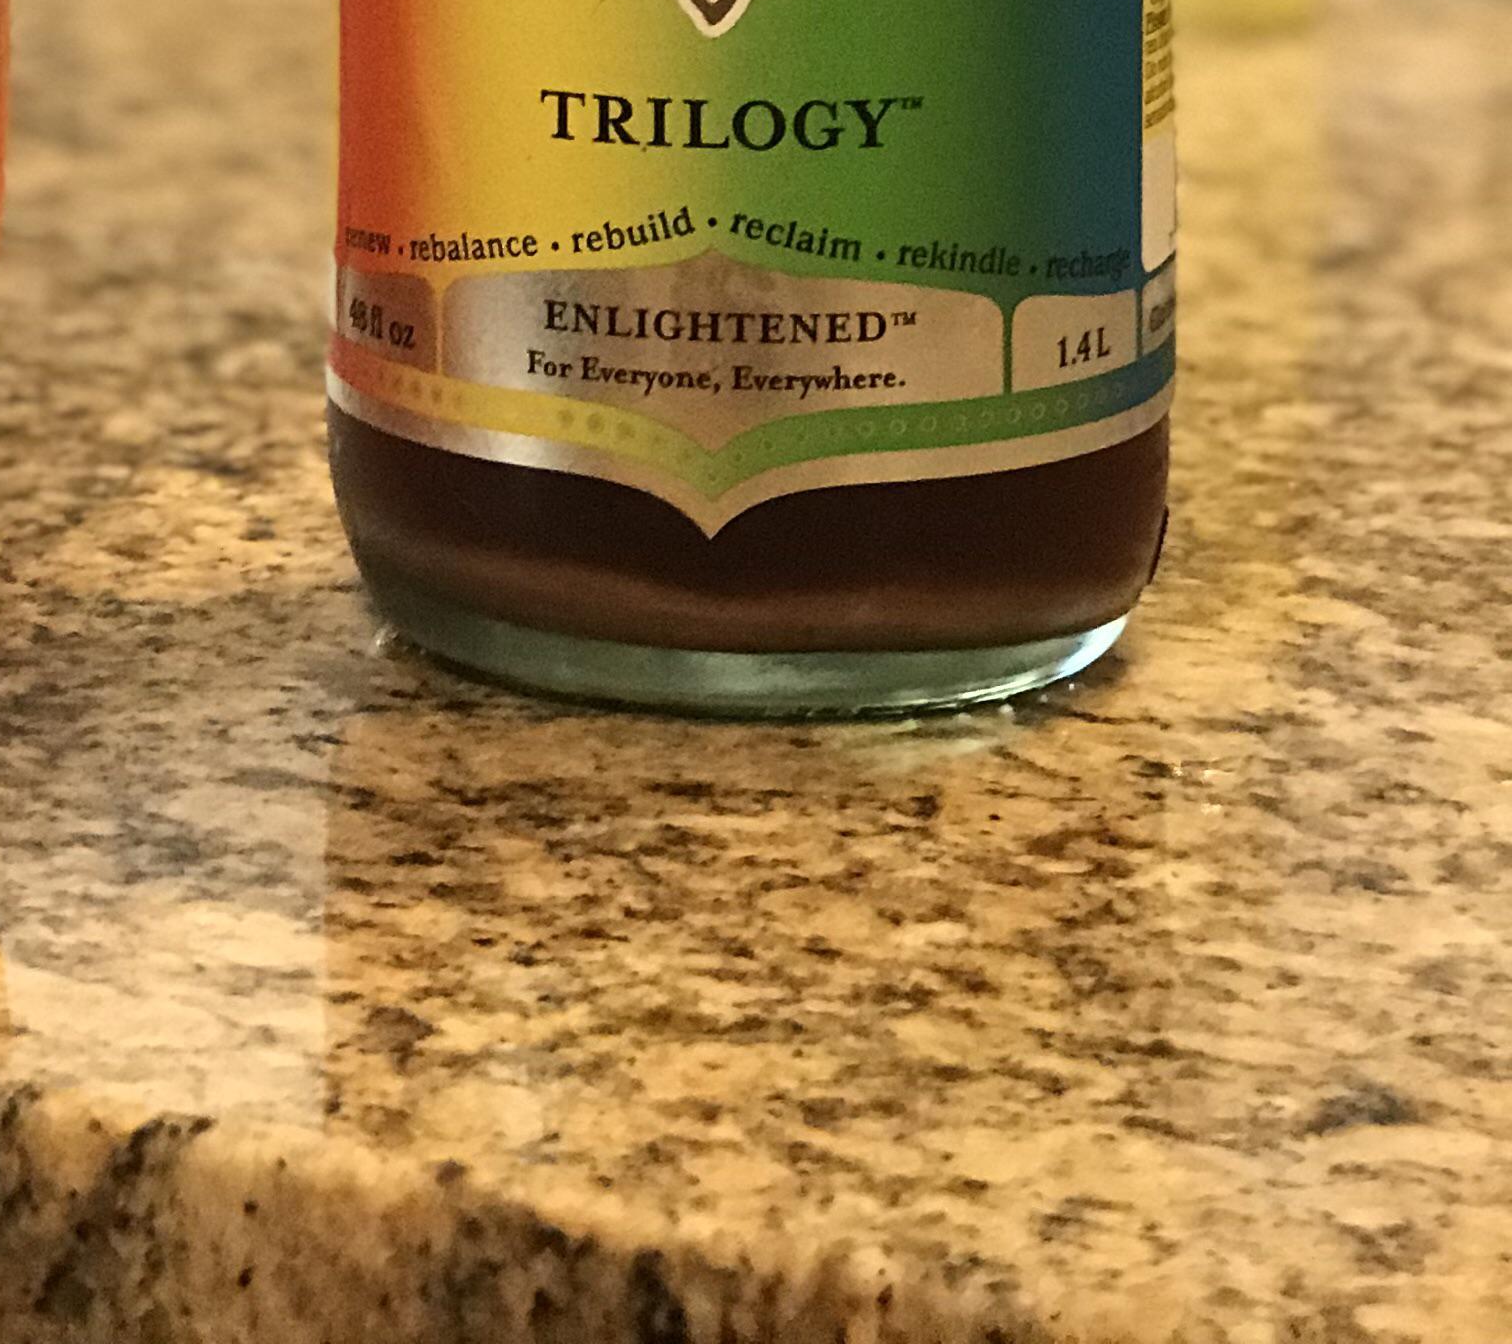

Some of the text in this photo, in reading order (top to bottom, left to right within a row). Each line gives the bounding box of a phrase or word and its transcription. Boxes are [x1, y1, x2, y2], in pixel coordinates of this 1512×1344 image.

[409, 231, 538, 263] rebalance
[571, 206, 697, 254] rebuild
[728, 209, 864, 263] reclaim
[896, 240, 1023, 279] rekindle
[388, 320, 416, 350] oz
[1057, 326, 1111, 369] 1.4 L
[527, 349, 907, 399] For Everyone, Everywhere.
